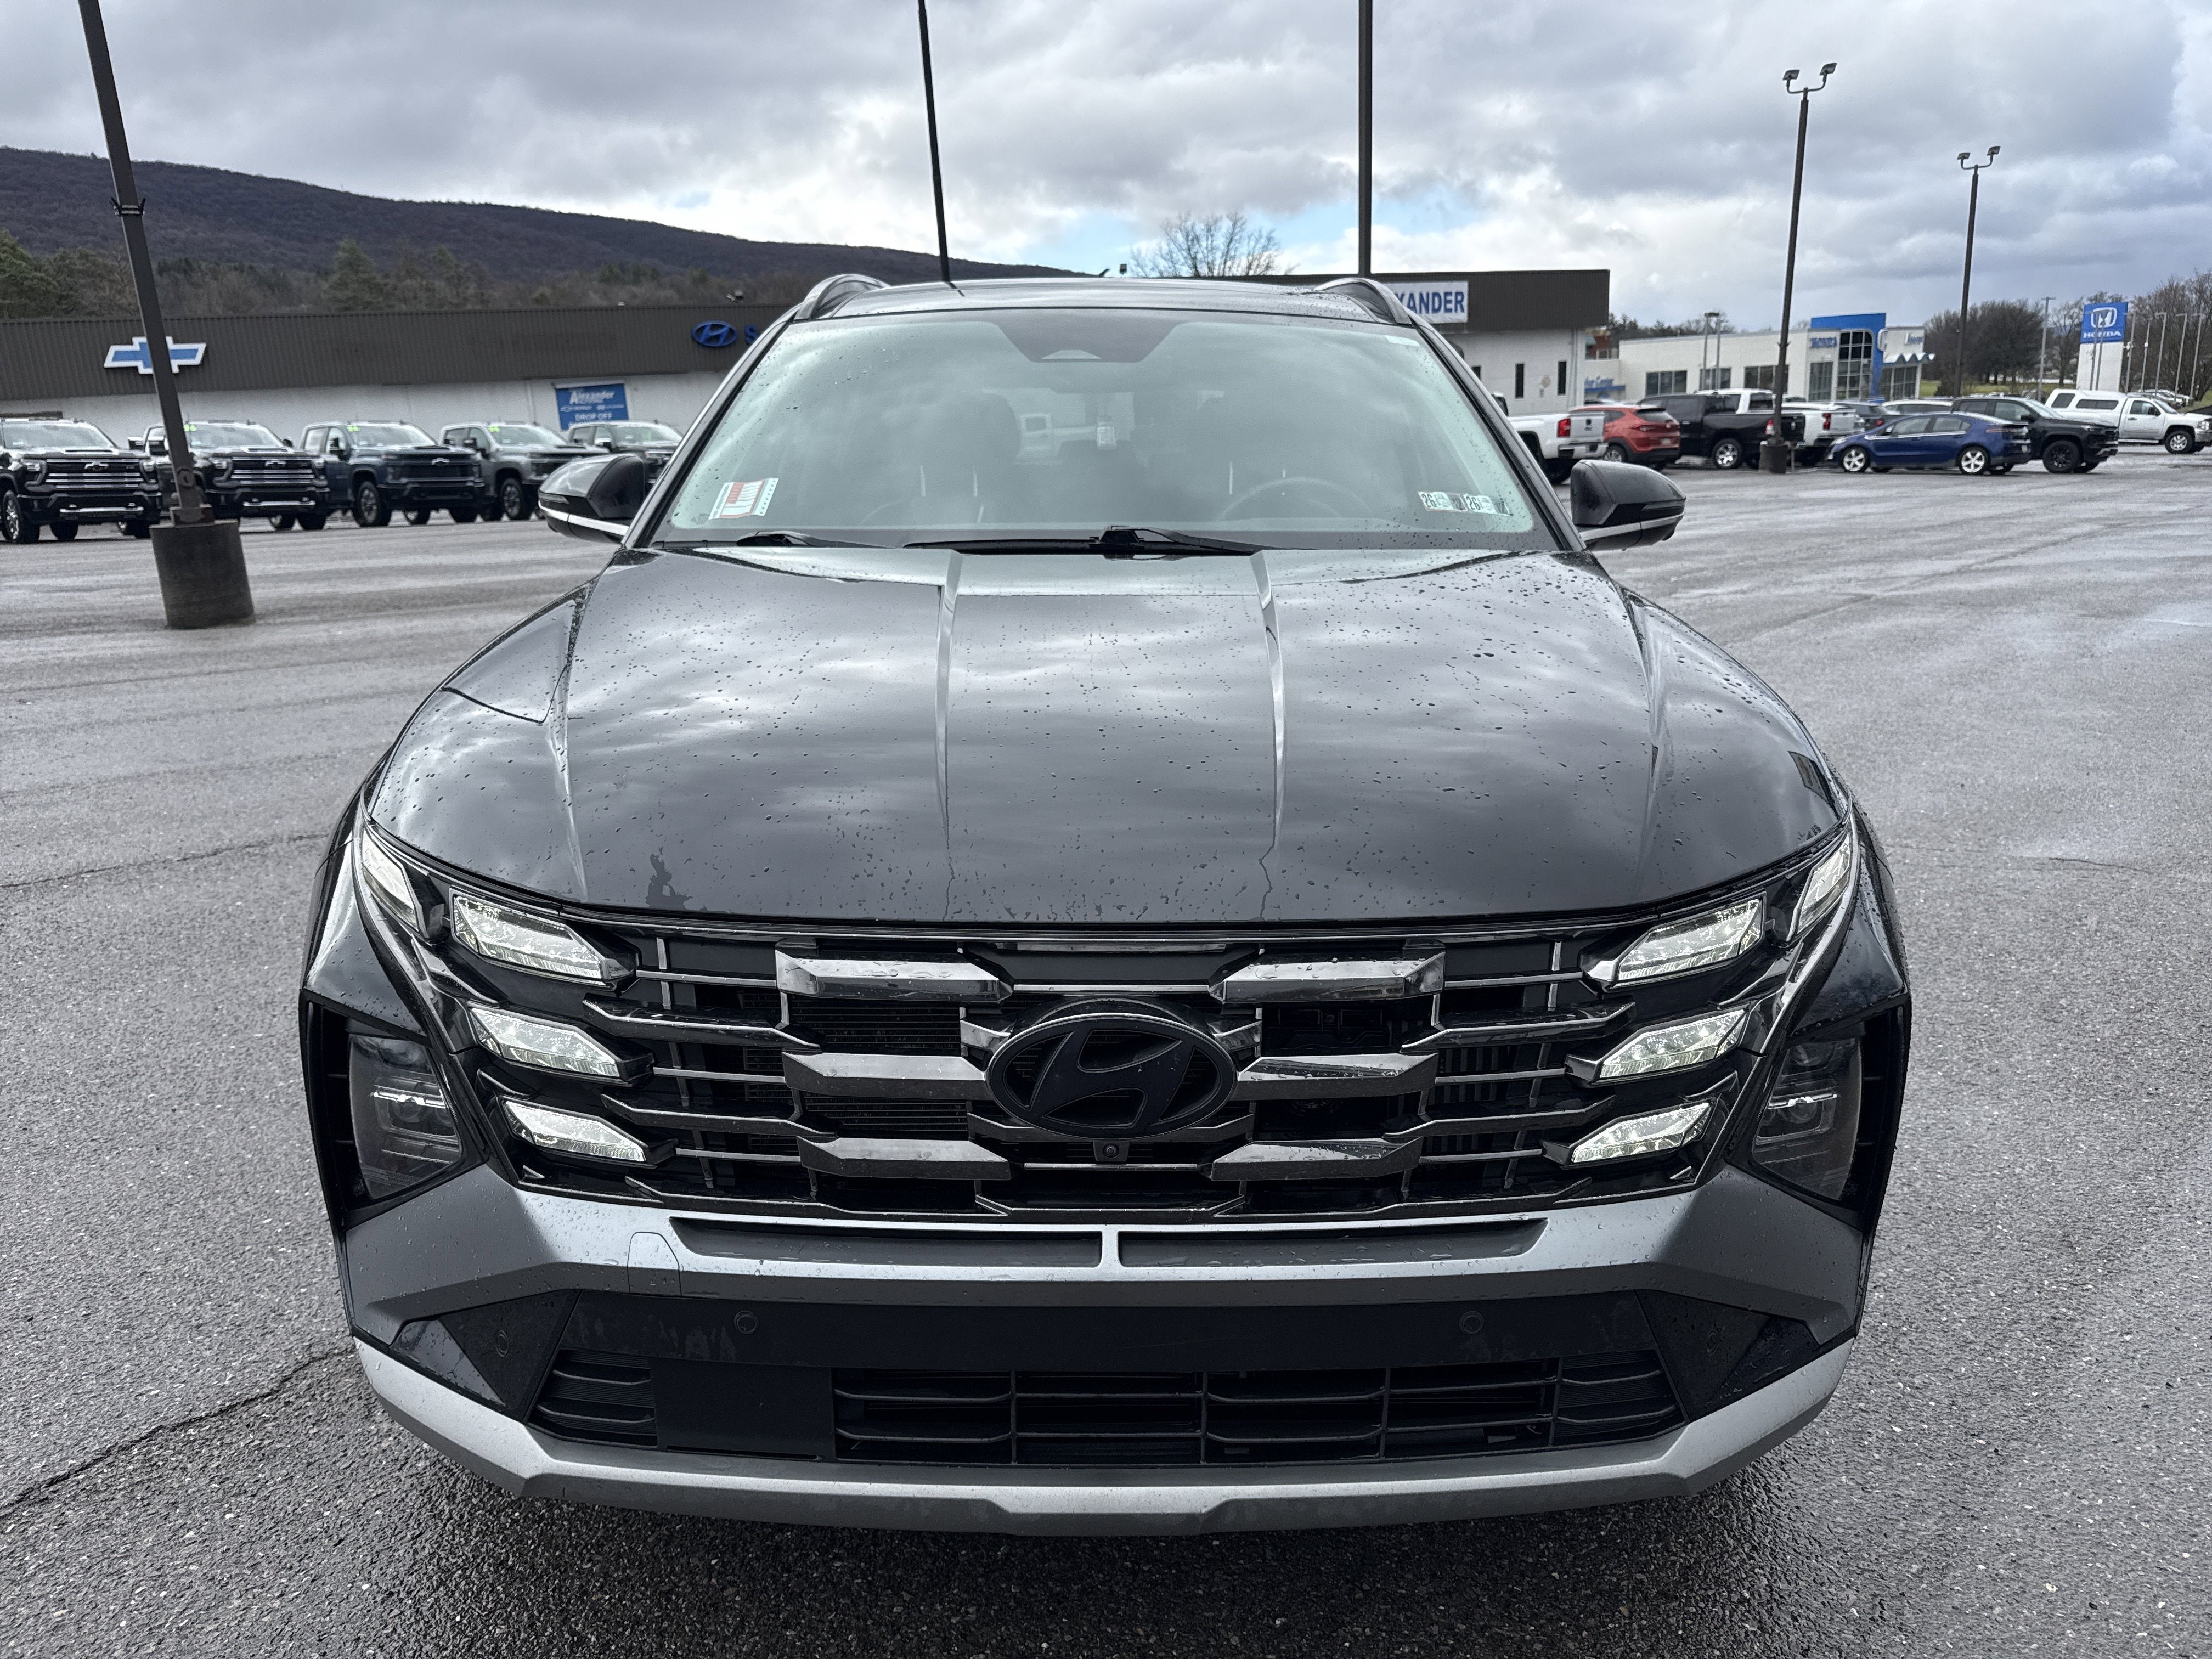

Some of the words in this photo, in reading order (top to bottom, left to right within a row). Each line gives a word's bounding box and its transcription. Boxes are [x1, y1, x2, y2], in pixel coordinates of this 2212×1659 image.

[569, 390, 614, 404] Alexander
[574, 413, 596, 421] DROP
[597, 411, 613, 420] OFF
[1421, 493, 1437, 508] 26
[1466, 496, 1481, 511] 26
